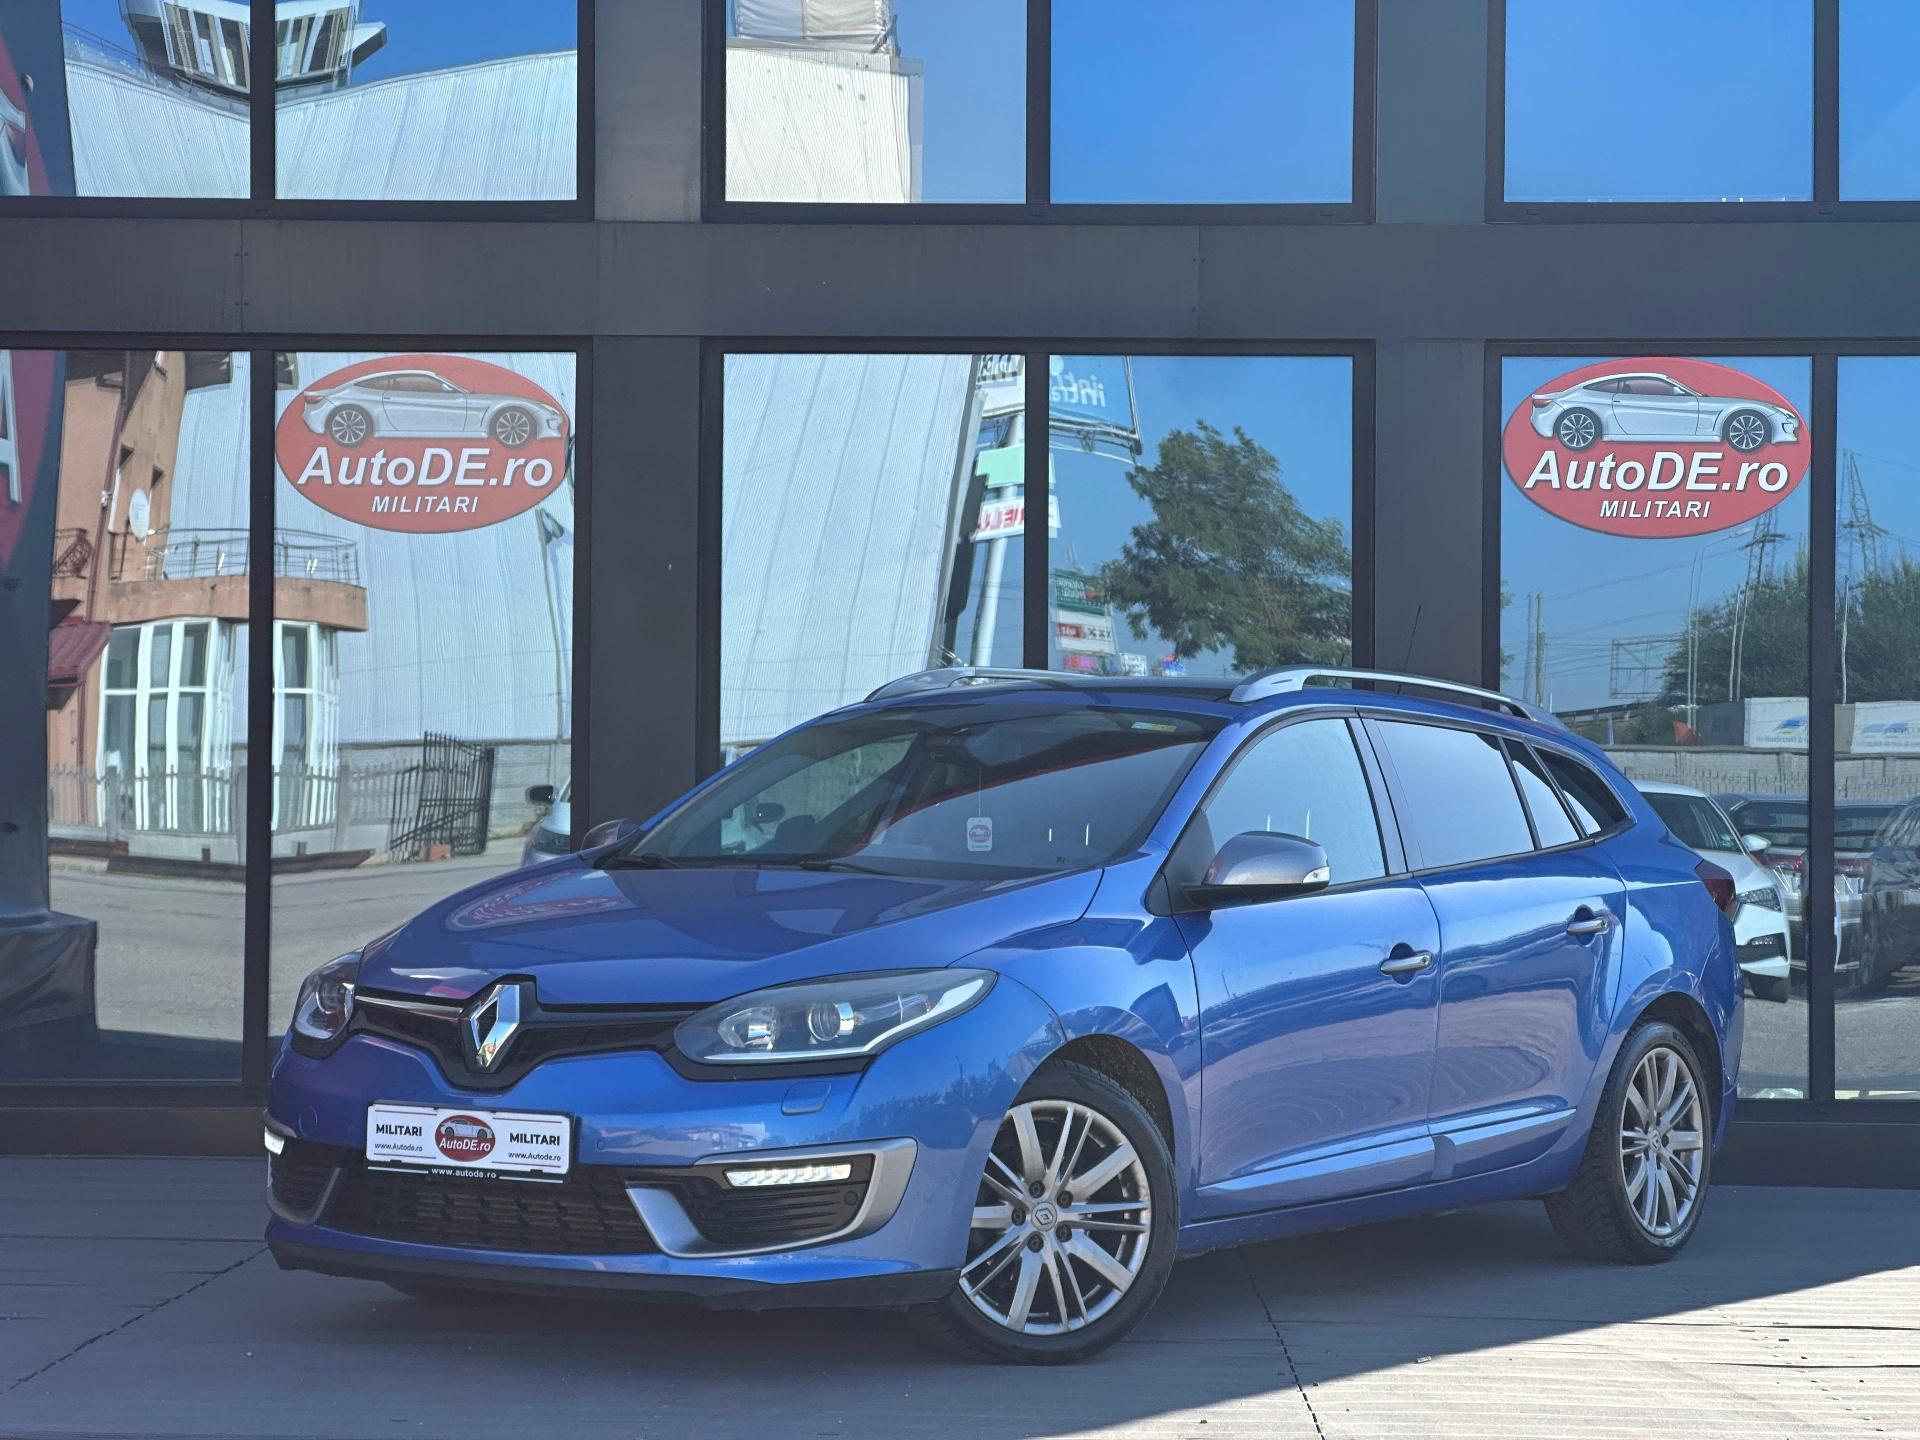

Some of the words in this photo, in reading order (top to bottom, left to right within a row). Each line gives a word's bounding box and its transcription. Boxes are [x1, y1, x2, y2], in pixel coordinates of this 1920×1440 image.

[297, 447, 553, 487] AutoDE.ro
[1524, 450, 1789, 492] AutoDE.ro
[371, 496, 479, 513] MILITARI
[1600, 500, 1711, 518] MILITARI
[375, 1123, 422, 1137] MILITARI
[438, 1137, 491, 1152] AutoDE.ro
[509, 1132, 560, 1146] MILITARI
[374, 1143, 423, 1152] www.Autode.ro
[508, 1152, 561, 1162] www.Autode.ro
[431, 1167, 497, 1179] www.autode.ro
